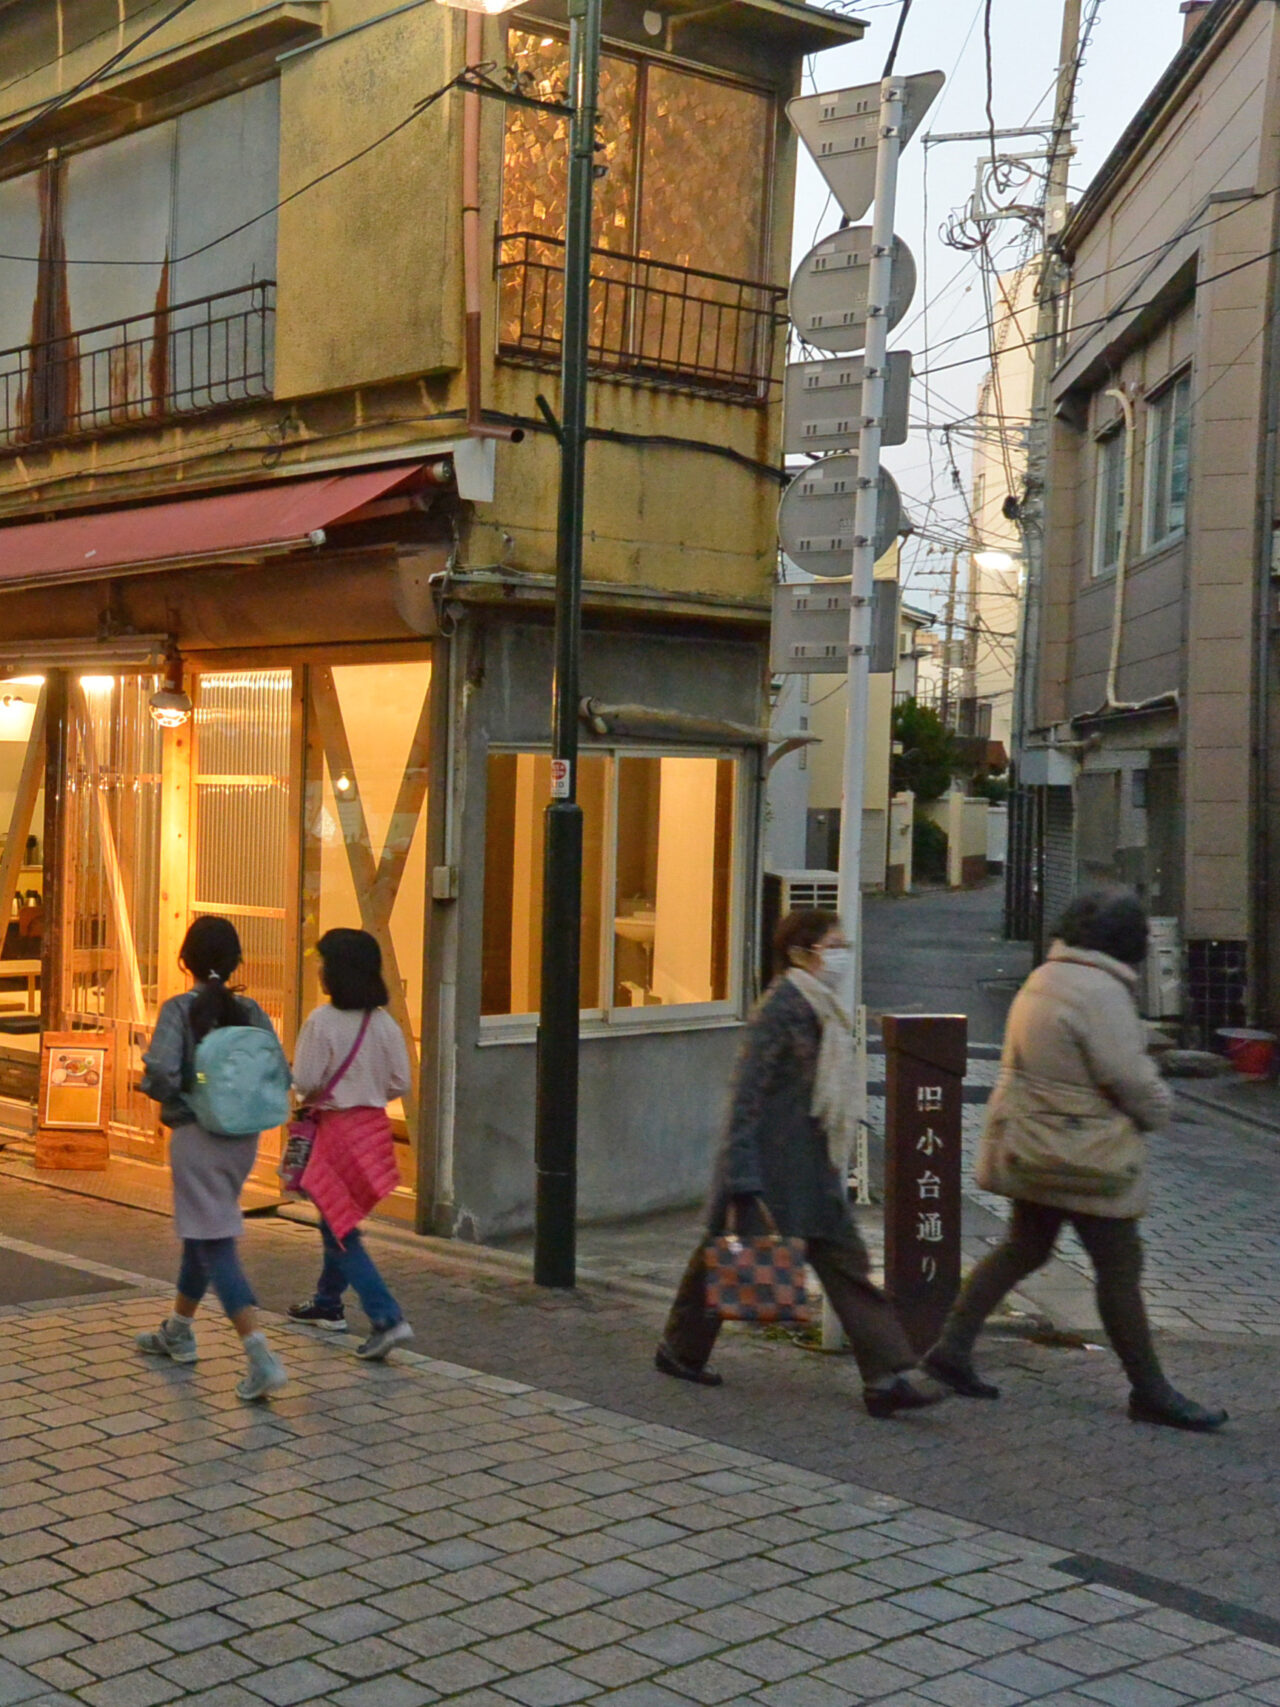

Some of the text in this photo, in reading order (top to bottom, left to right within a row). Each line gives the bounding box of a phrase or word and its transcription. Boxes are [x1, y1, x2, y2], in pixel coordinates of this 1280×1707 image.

[915, 1085, 945, 1283] 旧小台通り
